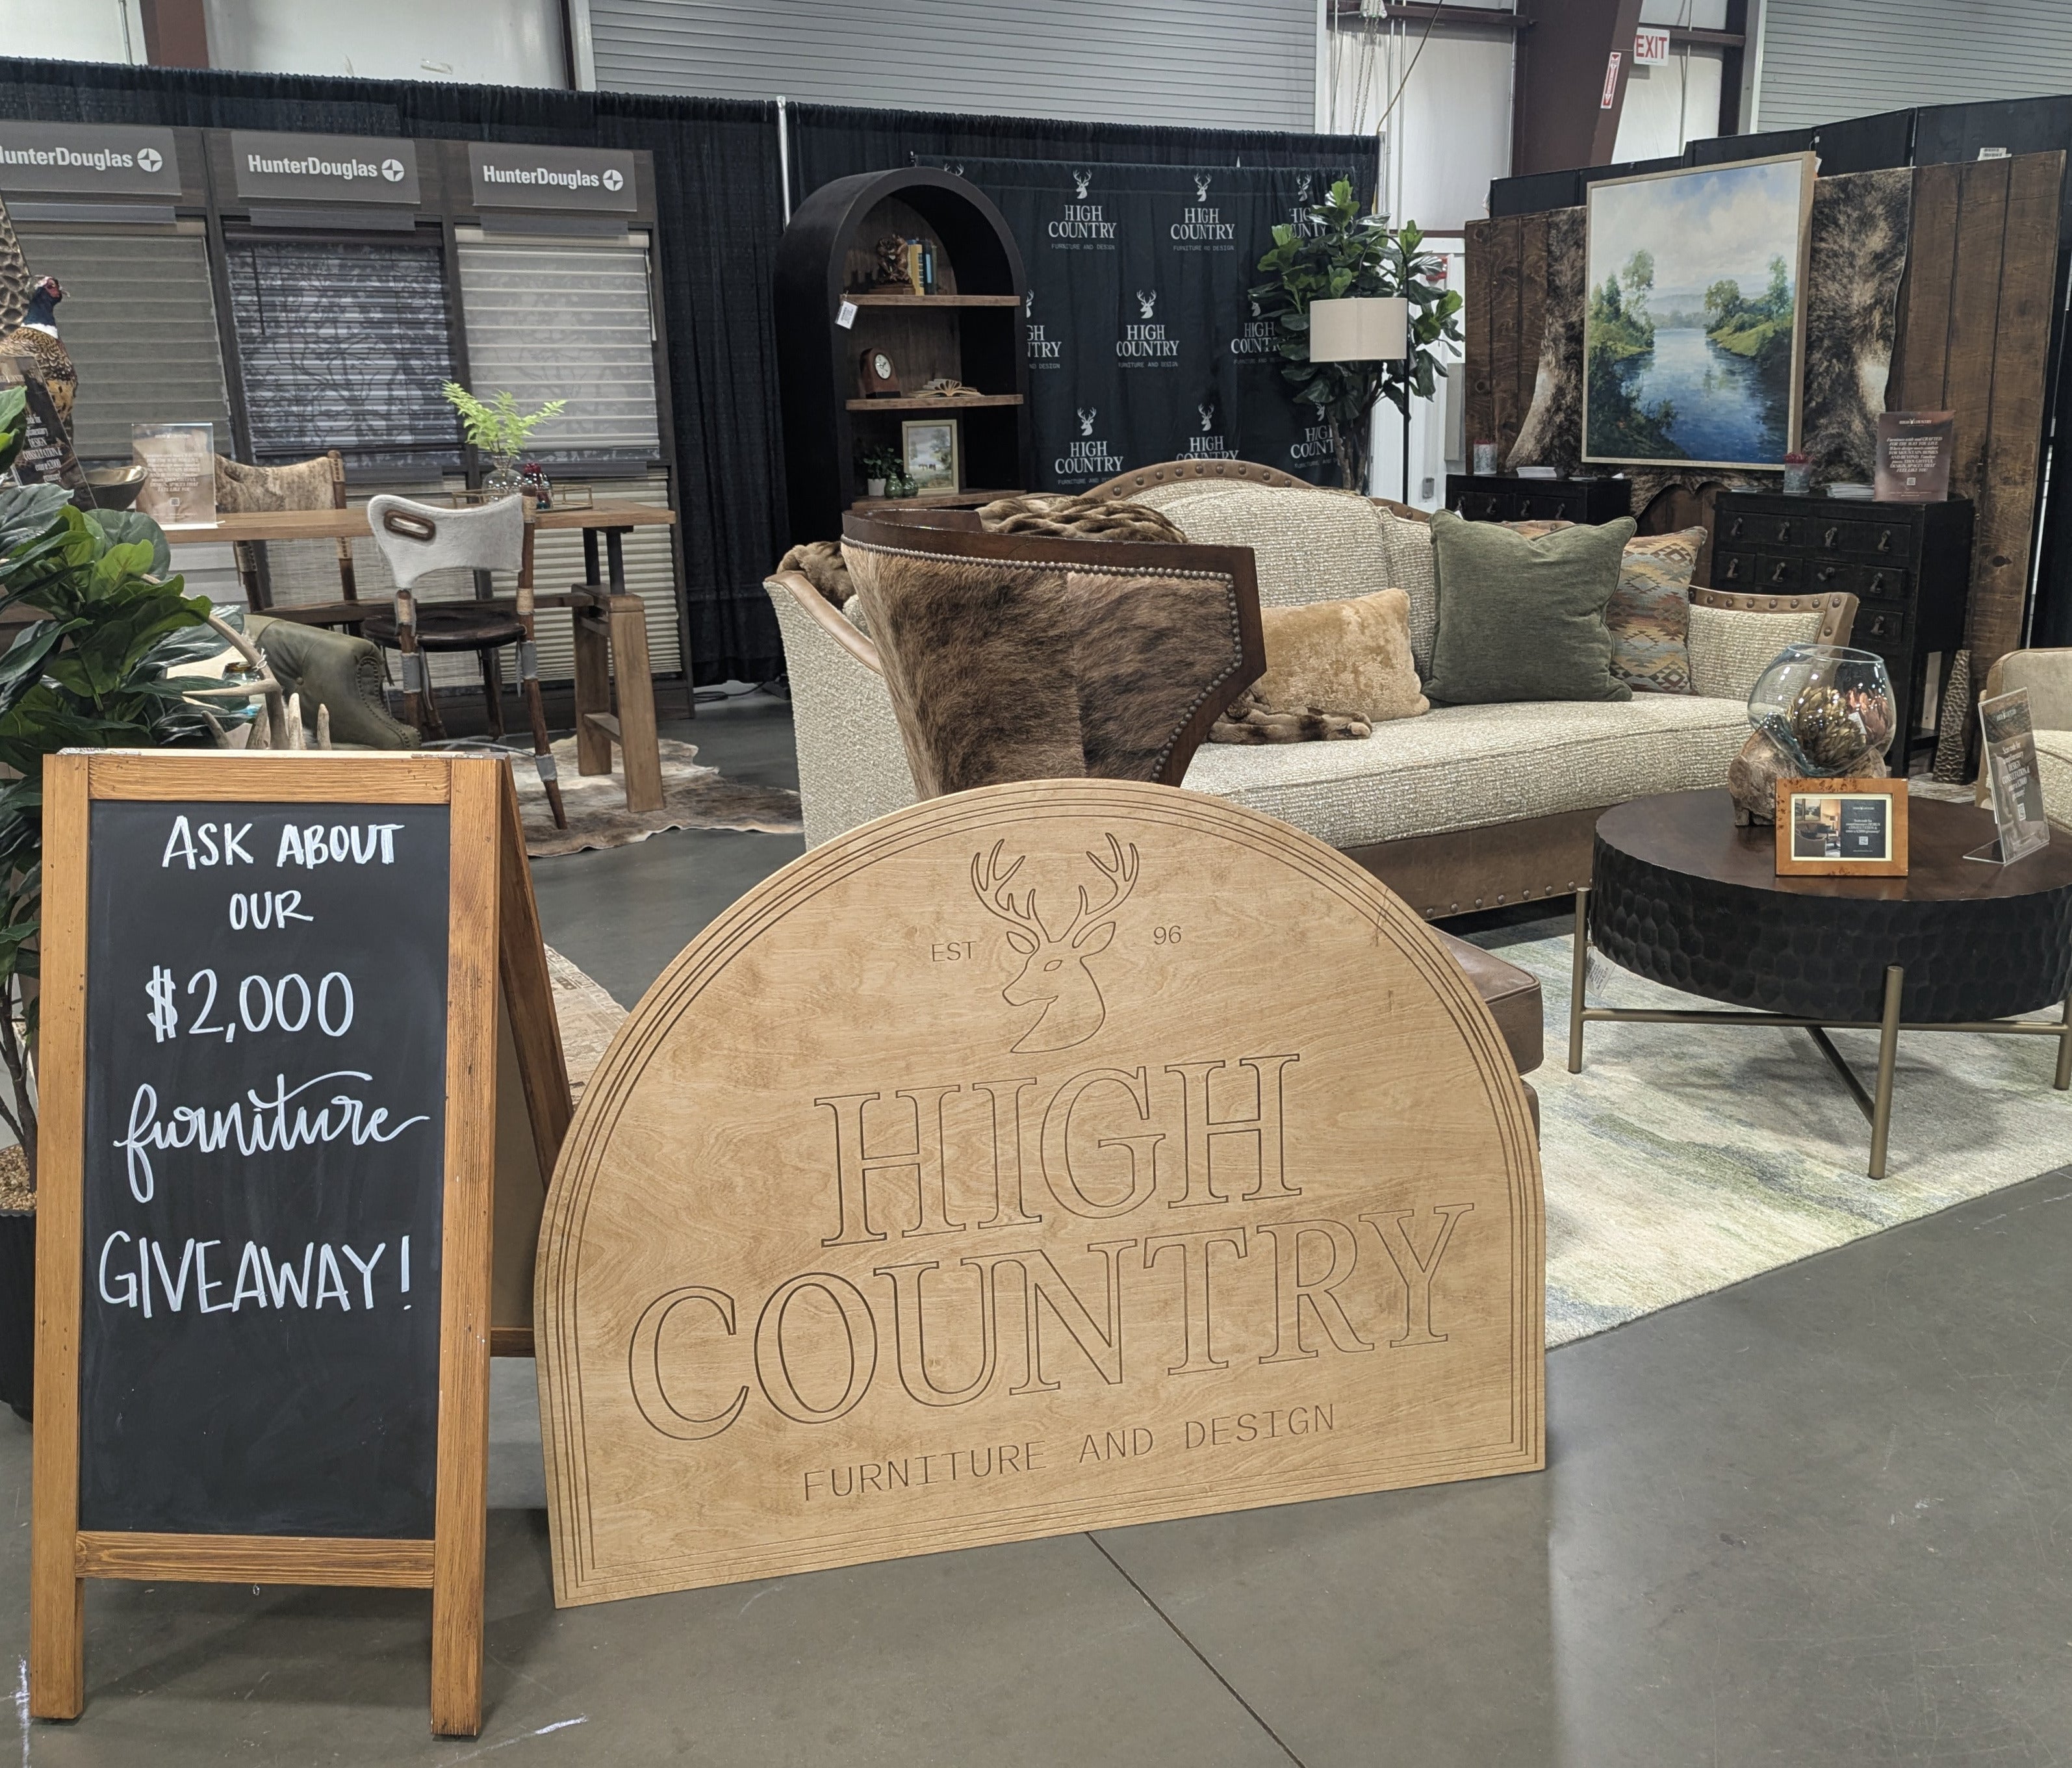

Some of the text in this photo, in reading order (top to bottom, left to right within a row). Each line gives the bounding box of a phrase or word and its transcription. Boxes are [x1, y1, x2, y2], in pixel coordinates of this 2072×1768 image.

[1635, 34, 1667, 59] EXIT
[248, 154, 377, 180] HunterDouglas
[483, 165, 600, 190] HunterDouglas
[1064, 205, 1103, 222] HIGH
[1184, 208, 1220, 224] HIGH
[1048, 221, 1117, 238] COUNTRY
[1170, 224, 1235, 240] COUNTRY
[1126, 324, 1165, 340] HIGH
[1244, 322, 1275, 337] HIGH
[1116, 340, 1180, 357] COUNTRY
[1069, 441, 1108, 457] HIGH
[1189, 435, 1224, 452] HIGH
[1055, 456, 1123, 474] COUNTRY
[162, 815, 405, 869] ASK ABOUT
[229, 890, 314, 930] OUR
[931, 925, 1182, 962] EST 96
[145, 965, 355, 1043] $2,000
[113, 1070, 430, 1203] furniture
[815, 1053, 1301, 1249] HIGH
[99, 1230, 412, 1318] GIVEAWAY!
[628, 1202, 1474, 1441] COUNTRY
[803, 1402, 1336, 1502] FURNITURE AND DESIGN
